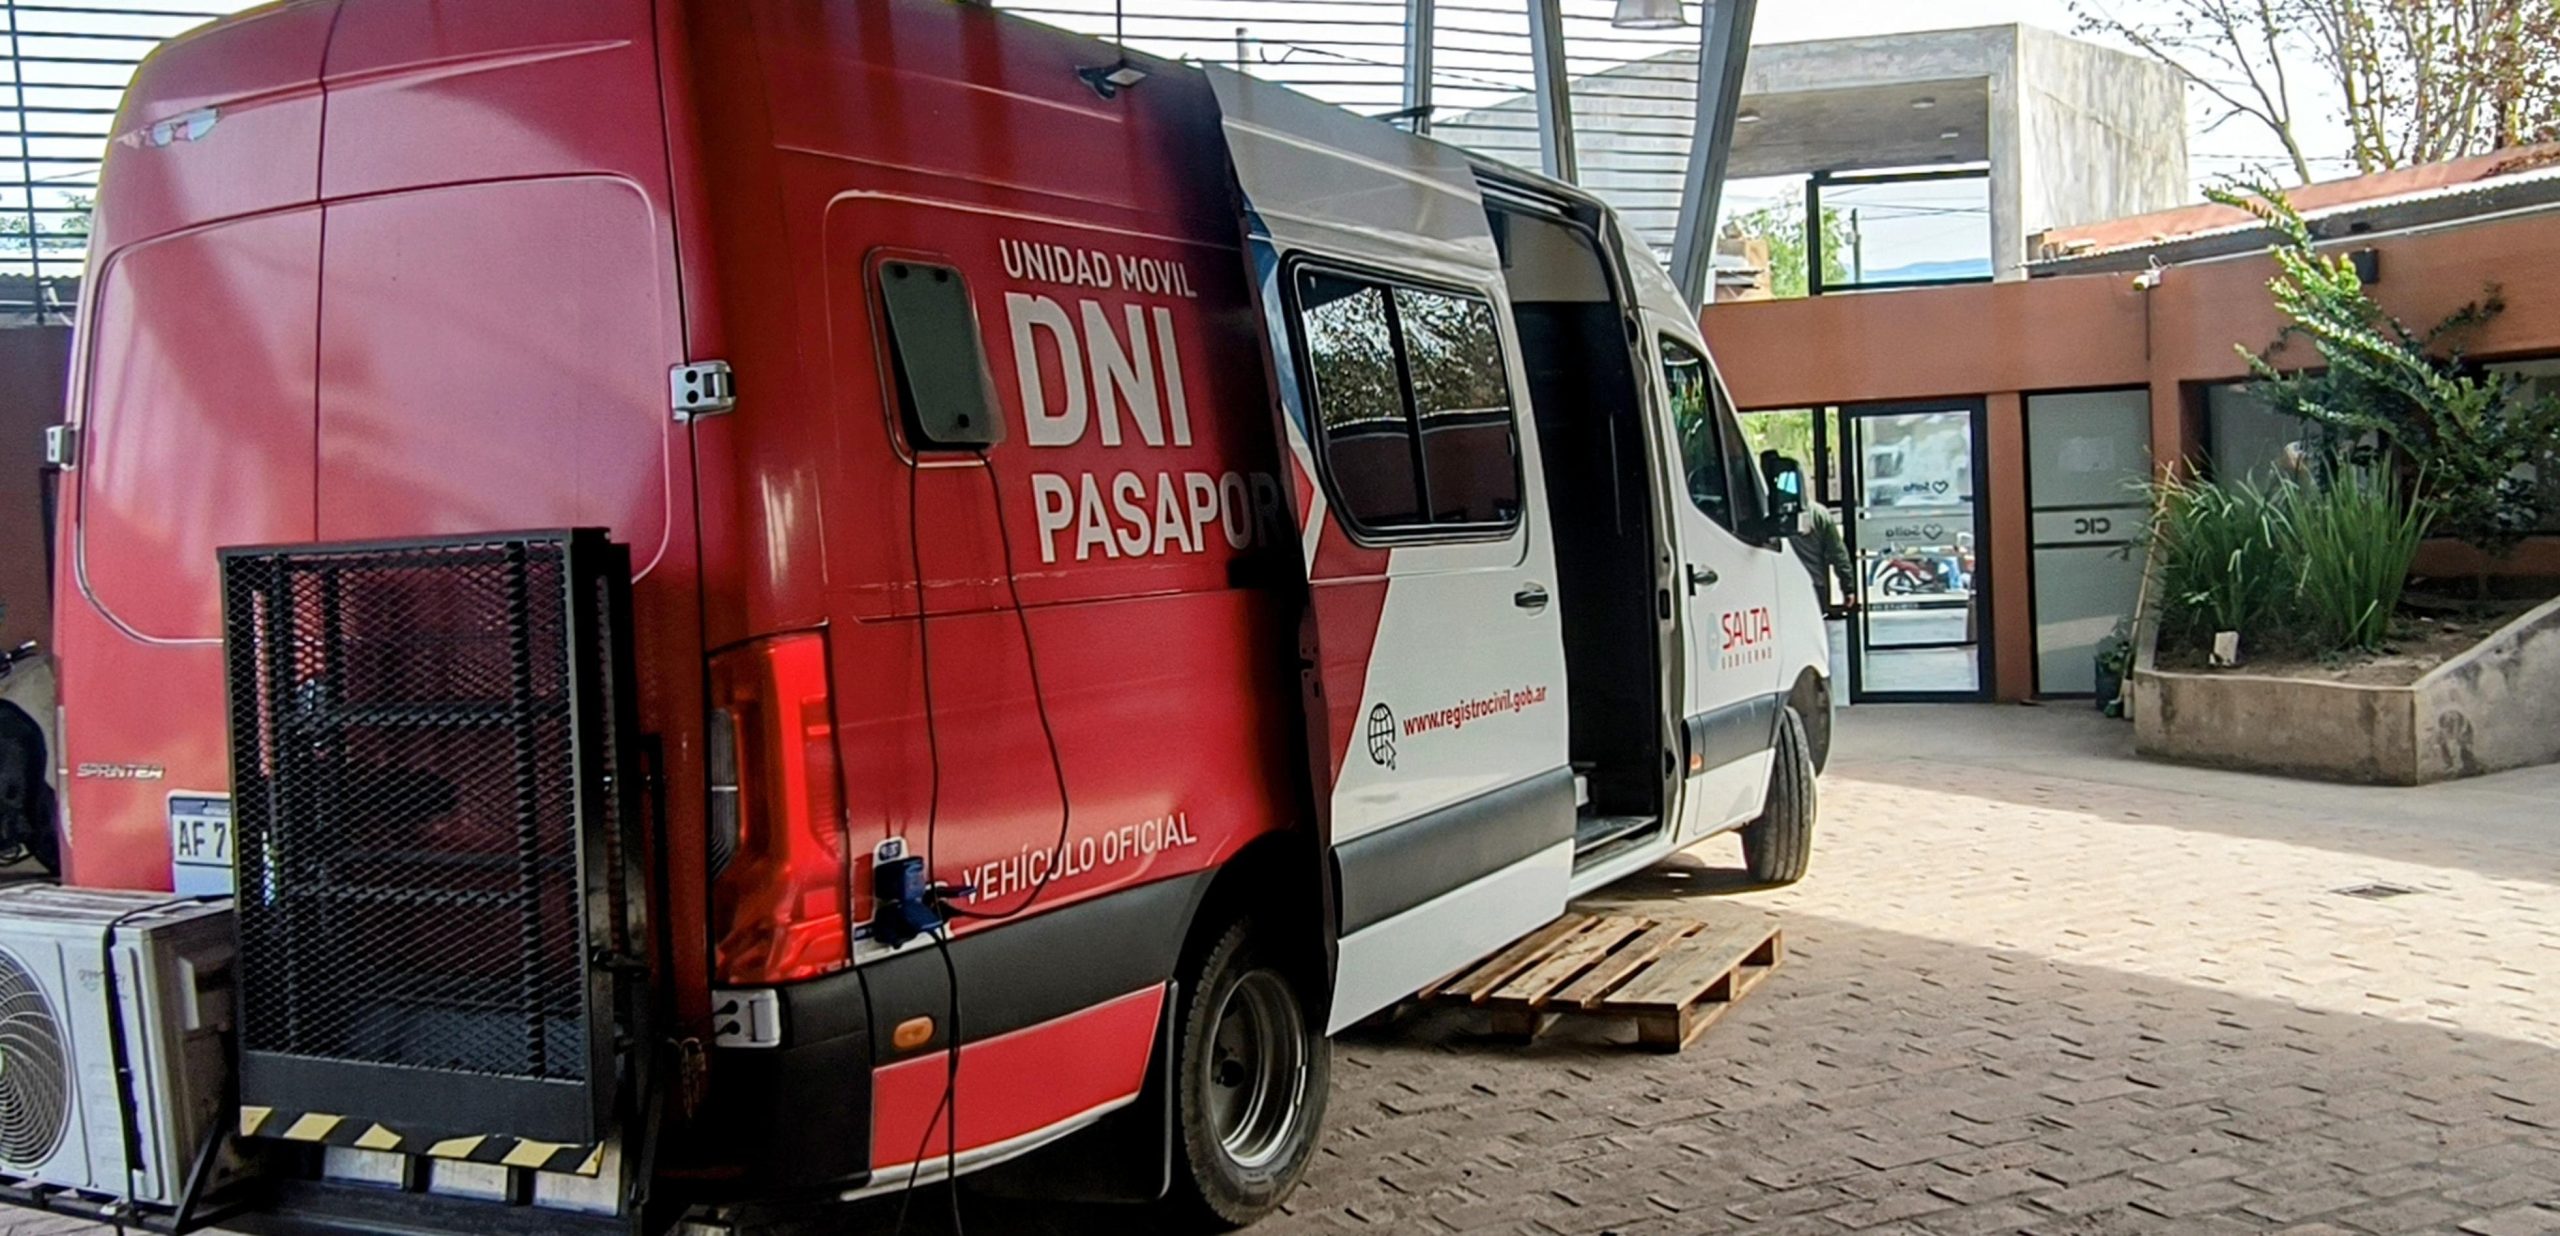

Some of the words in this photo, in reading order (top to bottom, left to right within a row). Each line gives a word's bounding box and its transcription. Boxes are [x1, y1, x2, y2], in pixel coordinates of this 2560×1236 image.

[1000, 238, 1113, 289] UNIDAD
[1116, 254, 1198, 298] MOVIL
[1004, 291, 1192, 446] DNI
[1721, 606, 1772, 650] SALTA
[1403, 686, 1547, 736] www.registrocivil.gob.ar
[76, 763, 166, 779] SPRINTER
[179, 820, 205, 857] AF
[214, 821, 226, 858] 7
[962, 837, 1096, 905] VEHÍCULO
[1102, 812, 1197, 864] OFICIAL
